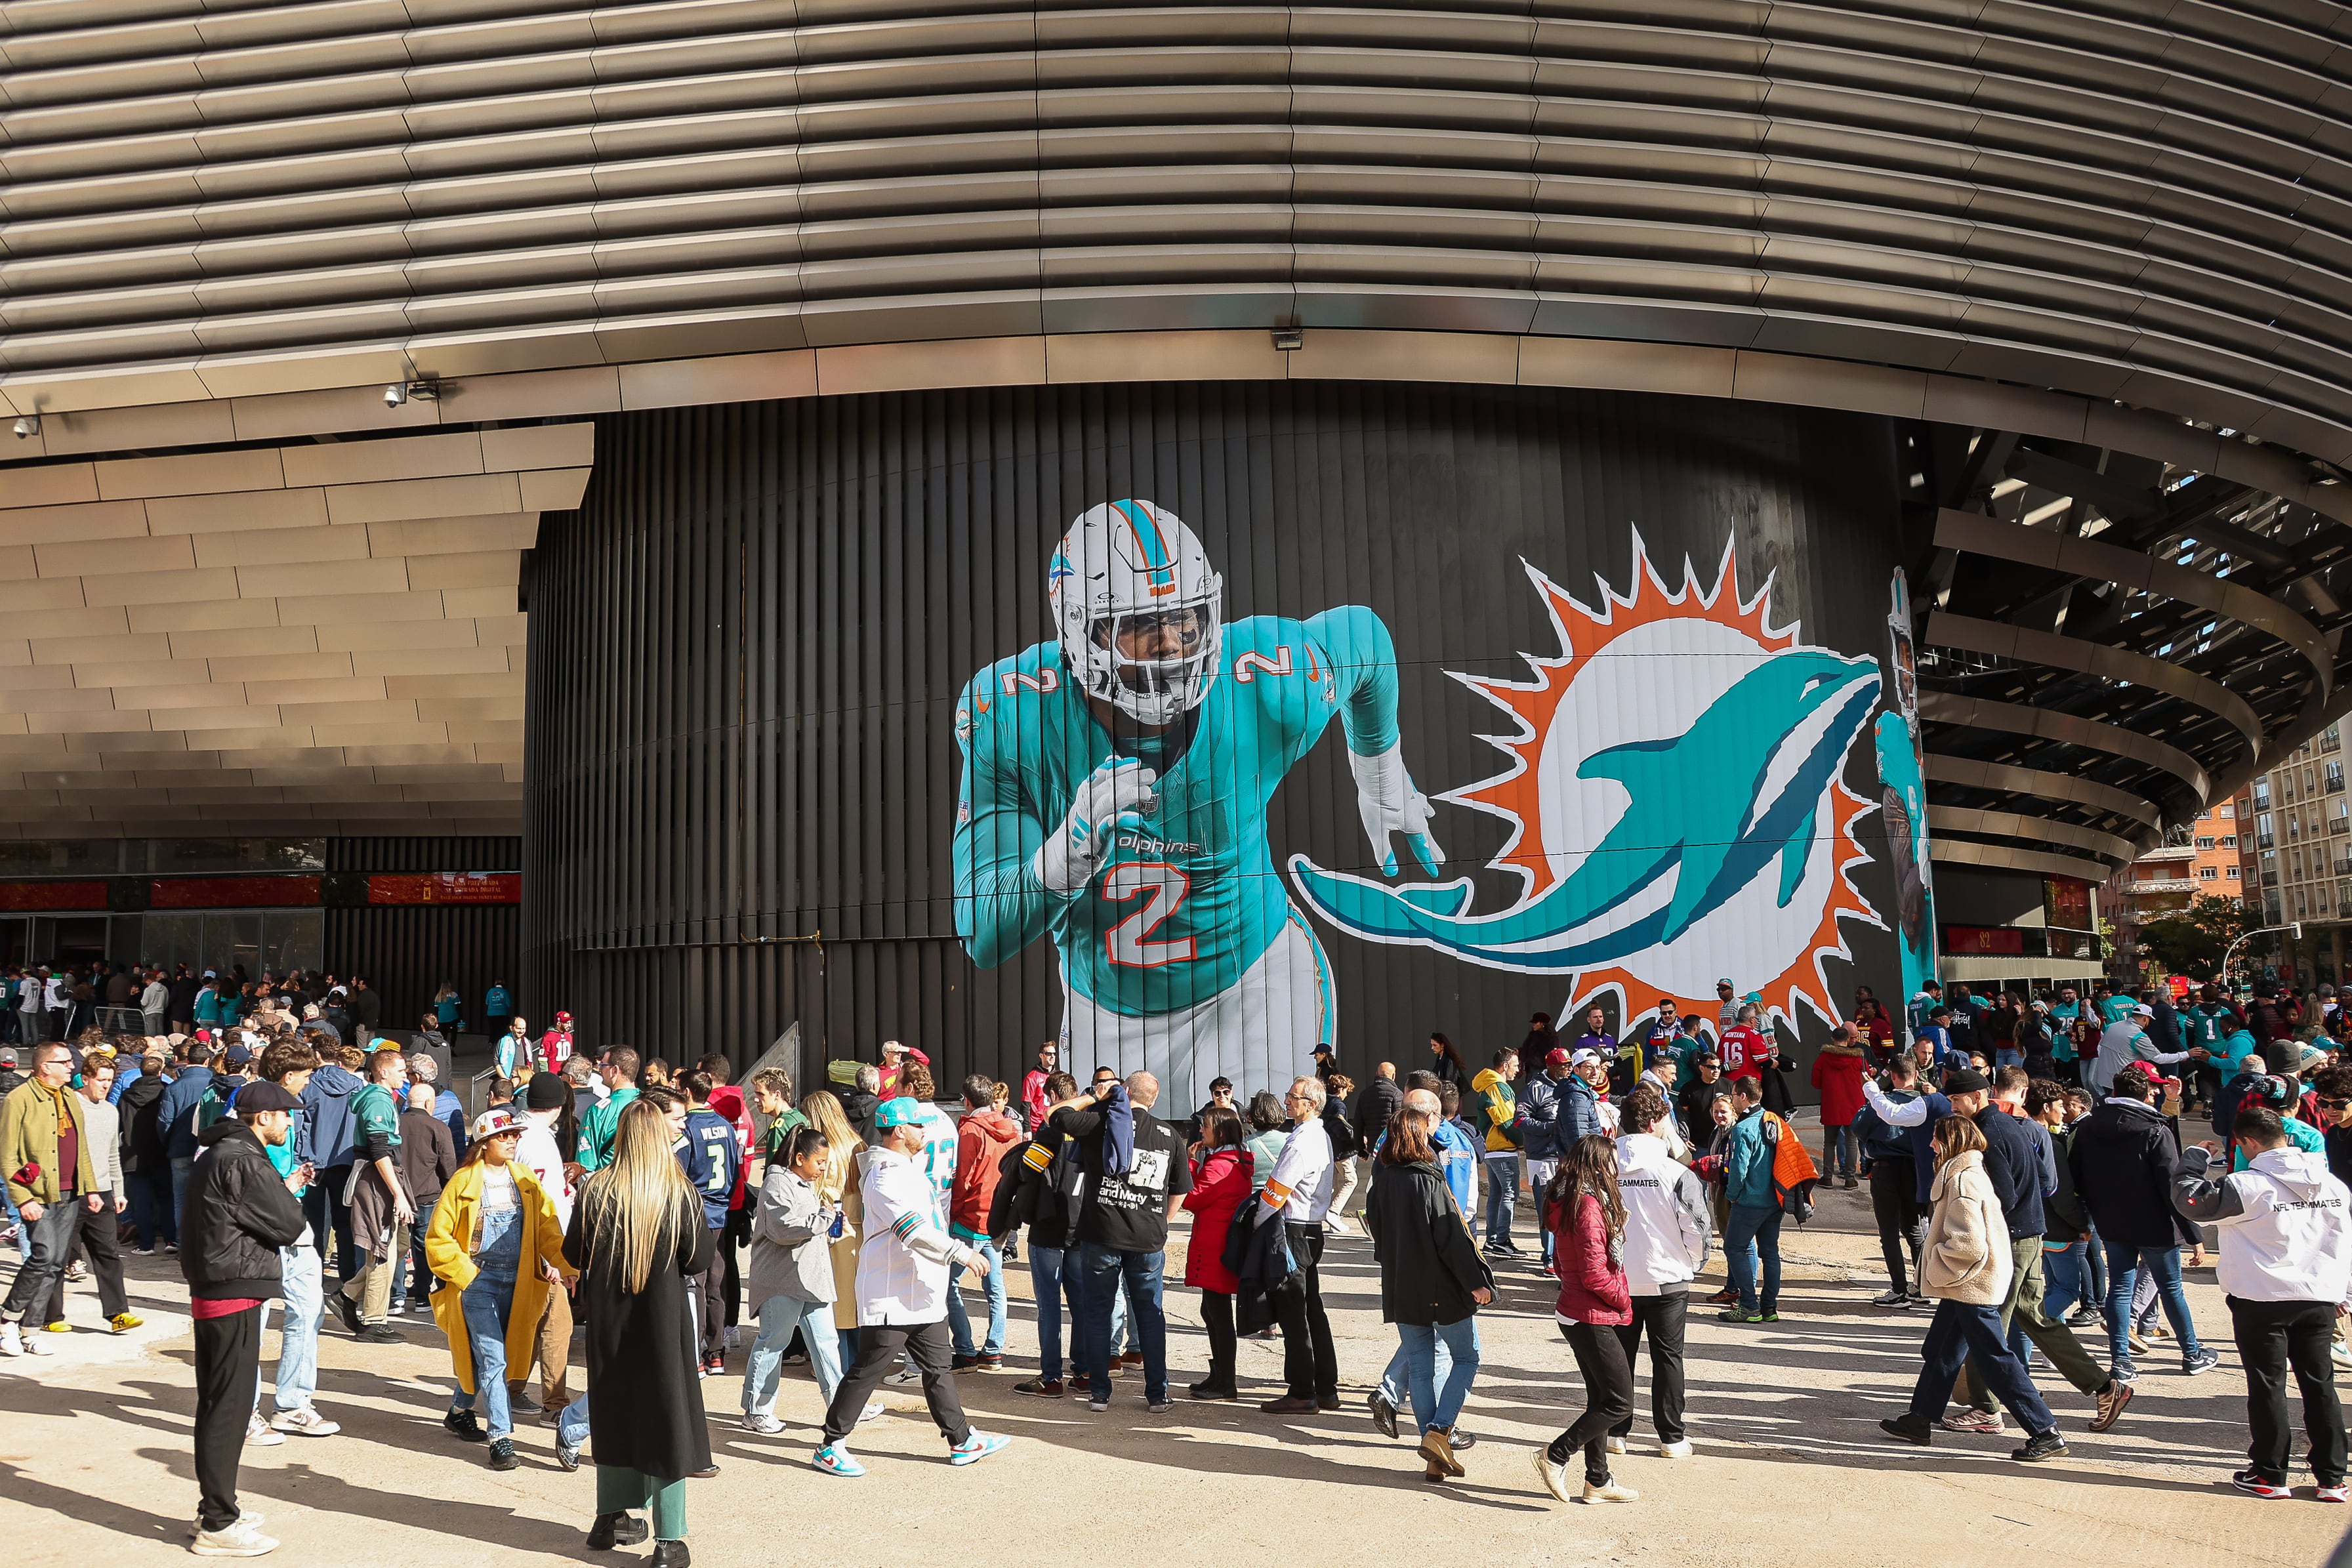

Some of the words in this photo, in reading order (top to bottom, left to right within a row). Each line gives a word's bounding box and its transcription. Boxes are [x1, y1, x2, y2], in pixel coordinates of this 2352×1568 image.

[1149, 583, 1176, 597] MIAMI
[1118, 833, 1200, 854] olphins
[1102, 861, 1198, 968] 2
[1979, 931, 1991, 949] 82
[2078, 1025, 2086, 1042] 5
[2205, 1018, 2217, 1040] 1
[556, 1041, 571, 1062] 10
[1723, 1041, 1744, 1063] 16
[700, 1125, 728, 1141] WILSON
[707, 1144, 726, 1191] 3
[924, 1138, 955, 1191] 13
[1101, 1176, 1123, 1189] Rick
[1099, 1186, 1119, 1199] and
[1119, 1188, 1147, 1205] Morty
[2273, 1203, 2289, 1212] NFL
[2290, 1199, 2342, 1211] TEAMMATES
